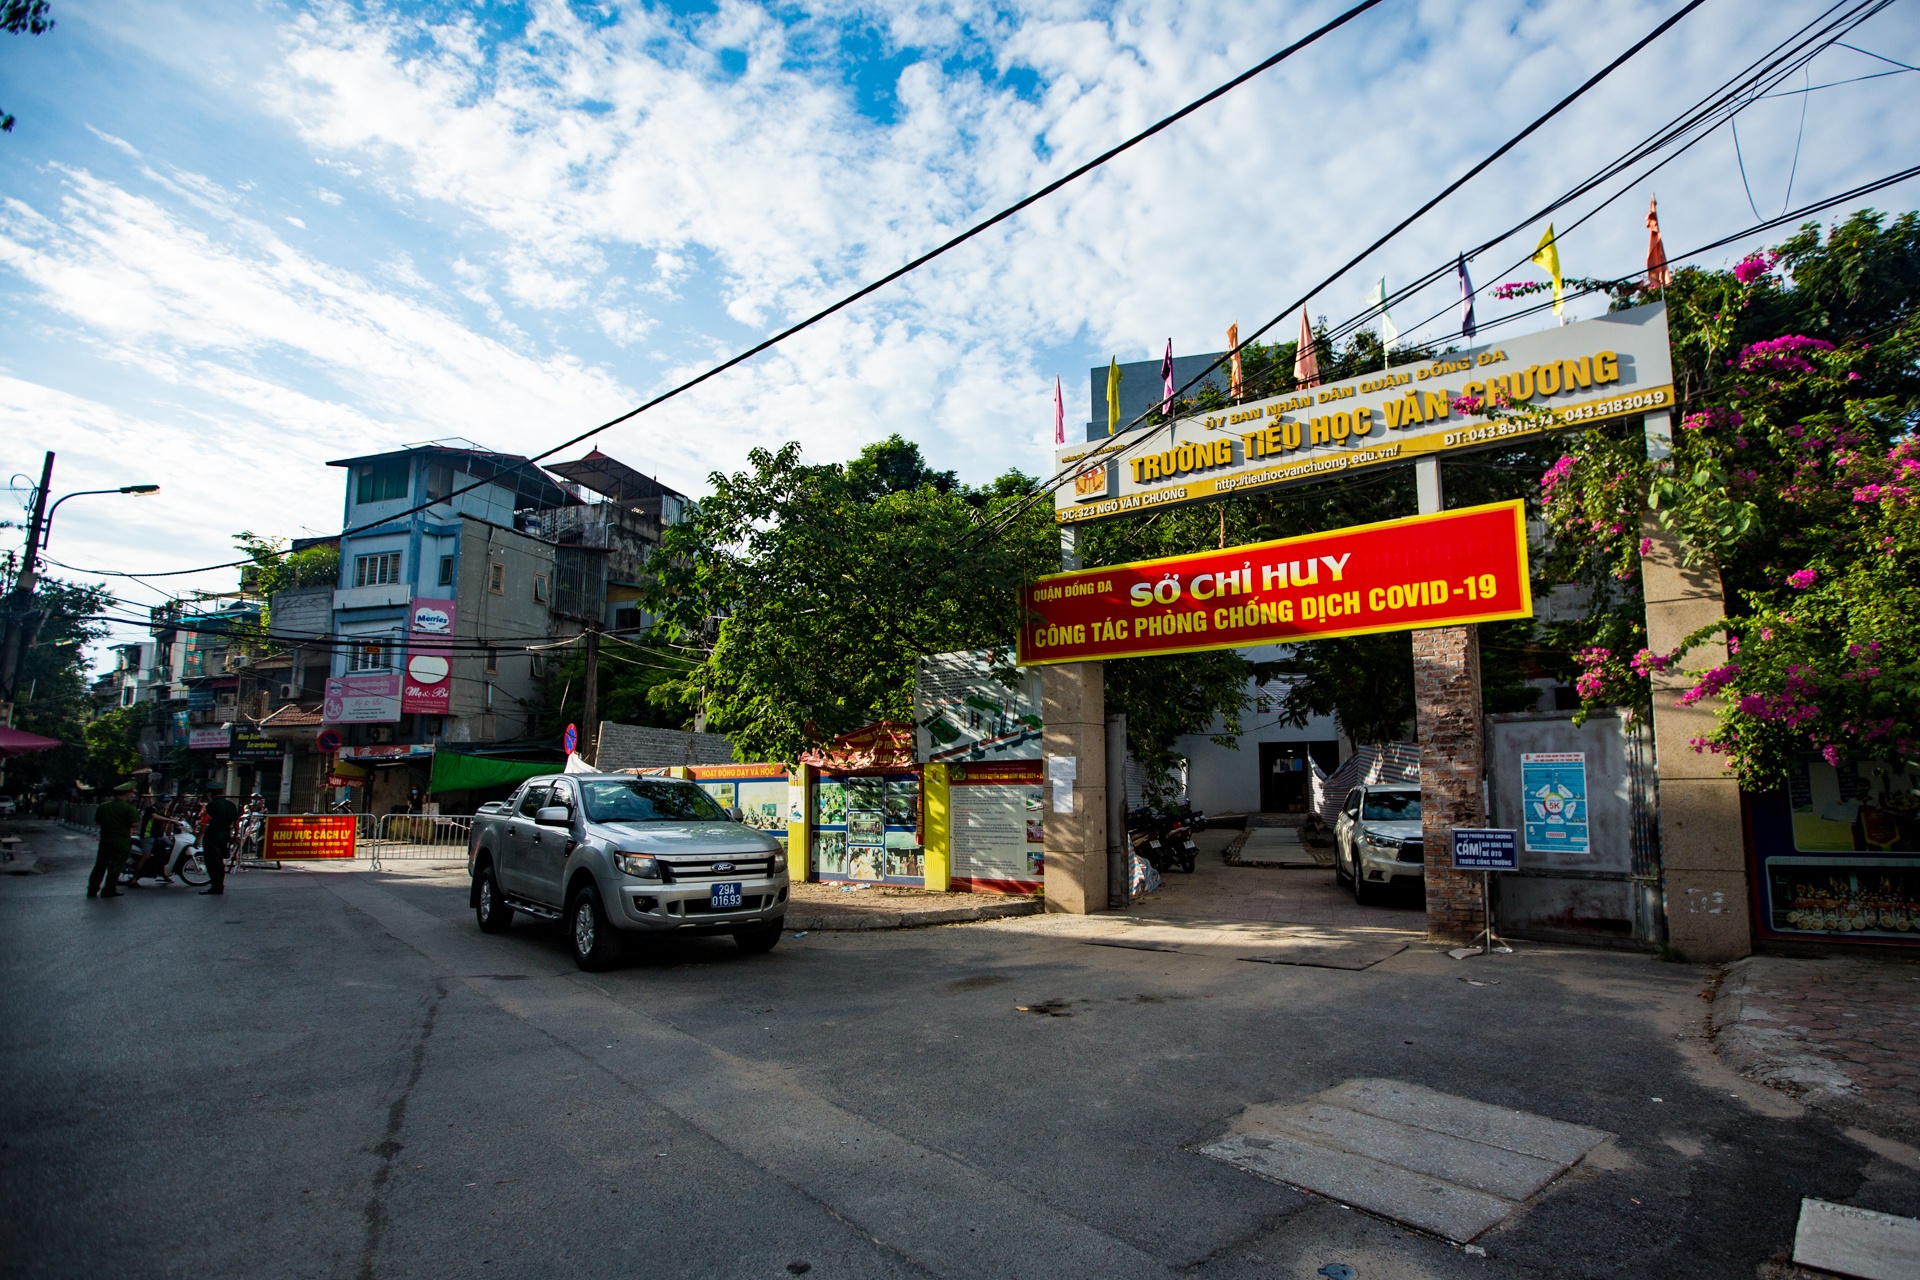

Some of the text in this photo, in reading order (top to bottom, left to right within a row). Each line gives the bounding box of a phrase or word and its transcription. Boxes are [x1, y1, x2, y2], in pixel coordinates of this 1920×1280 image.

[1205, 350, 1507, 430] ỦY BAN NHÂN DÂN QUẬN ĐỐNG ĐA
[1129, 438, 1233, 484] TRƯỜNG
[1241, 413, 1302, 460] TIỂU
[1310, 405, 1373, 449] HỌC
[1383, 388, 1448, 430] VĂN
[1462, 350, 1620, 410] CHƯƠNG
[1565, 391, 1664, 423] 043.5183049
[1097, 500, 1118, 514] NGÕ
[1119, 497, 1141, 510] VĂN
[1142, 487, 1186, 505] CHƯƠNG
[1033, 579, 1113, 603] QUẬN ĐỐNG ĐA
[1130, 552, 1352, 608] SỞ CHỈ HUY
[417, 614, 448, 624] Merries
[1034, 621, 1086, 648] CÔNG
[1091, 616, 1129, 642] TÁC
[1135, 608, 1207, 638] PHÒNG
[1214, 596, 1294, 630] CHỐNG
[1301, 590, 1361, 624] DỊCH
[702, 766, 775, 779] HOẠT ĐỘNG DẠY VÀ HỌC
[273, 828, 351, 842] KHU VỰC CÁCH LY
[1456, 839, 1479, 856] CẤM
[718, 883, 735, 896] 29A
